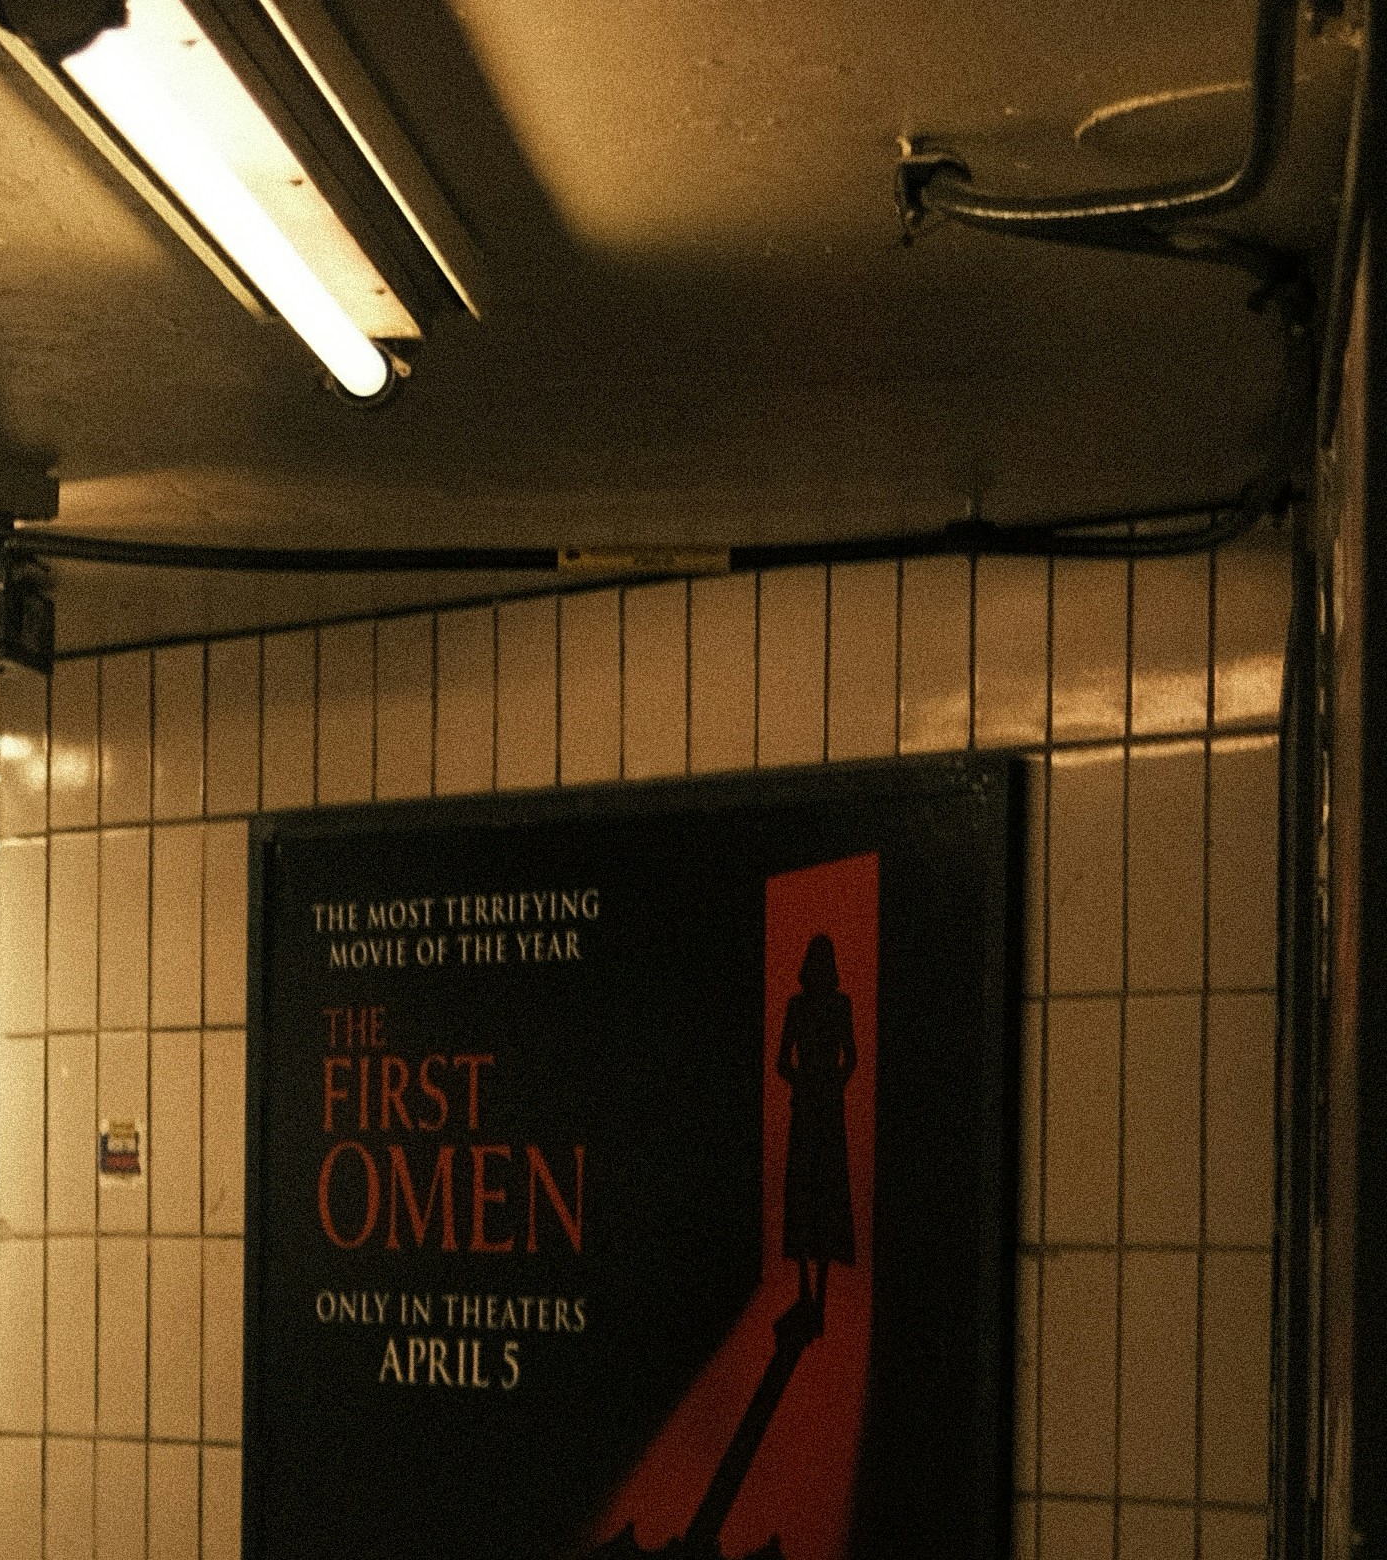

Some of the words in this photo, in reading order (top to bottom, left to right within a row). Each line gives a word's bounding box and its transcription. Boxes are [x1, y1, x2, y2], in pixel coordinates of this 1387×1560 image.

[312, 900, 360, 933] THE
[367, 896, 435, 929] MOST
[445, 888, 601, 927] TERRIFYING
[328, 935, 409, 971] MOVIE
[415, 935, 450, 967] OF
[456, 931, 510, 965] THE
[515, 929, 582, 964] YEAR
[325, 1006, 387, 1049] THE
[322, 1052, 495, 1134] FIRST
[315, 1140, 587, 1254] OMEN
[315, 1290, 391, 1327] ONLY
[400, 1293, 434, 1329] IN
[443, 1294, 588, 1334] THEATERS
[379, 1336, 492, 1388] APRIL
[500, 1340, 520, 1391] 5
